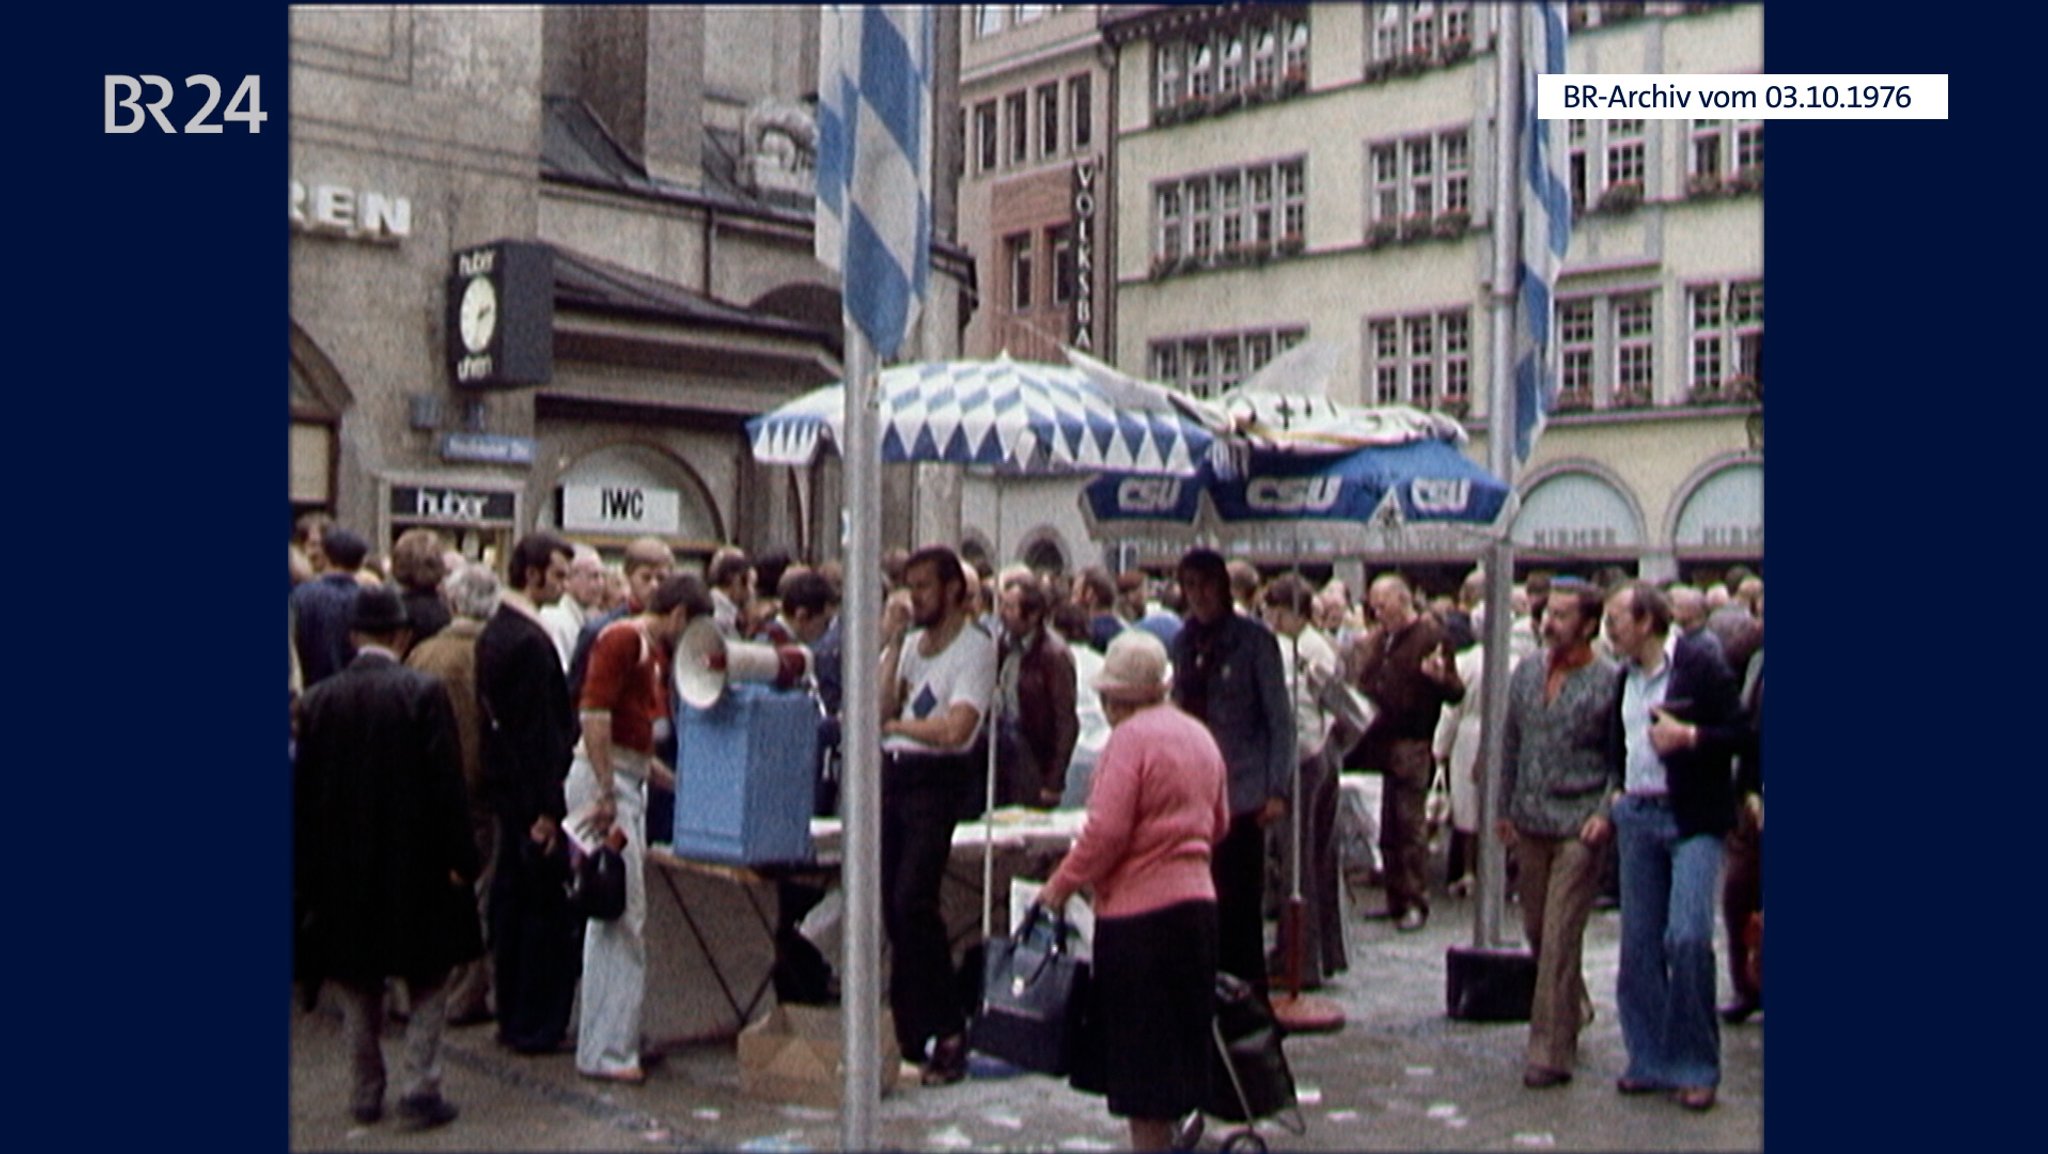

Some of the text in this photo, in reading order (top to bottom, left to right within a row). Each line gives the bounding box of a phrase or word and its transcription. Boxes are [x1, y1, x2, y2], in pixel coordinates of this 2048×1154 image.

[417, 487, 489, 519] huber
[602, 488, 644, 520] IWC
[1118, 478, 1183, 512] CSU
[1246, 475, 1344, 512] CSU
[1411, 476, 1471, 512] CSU
